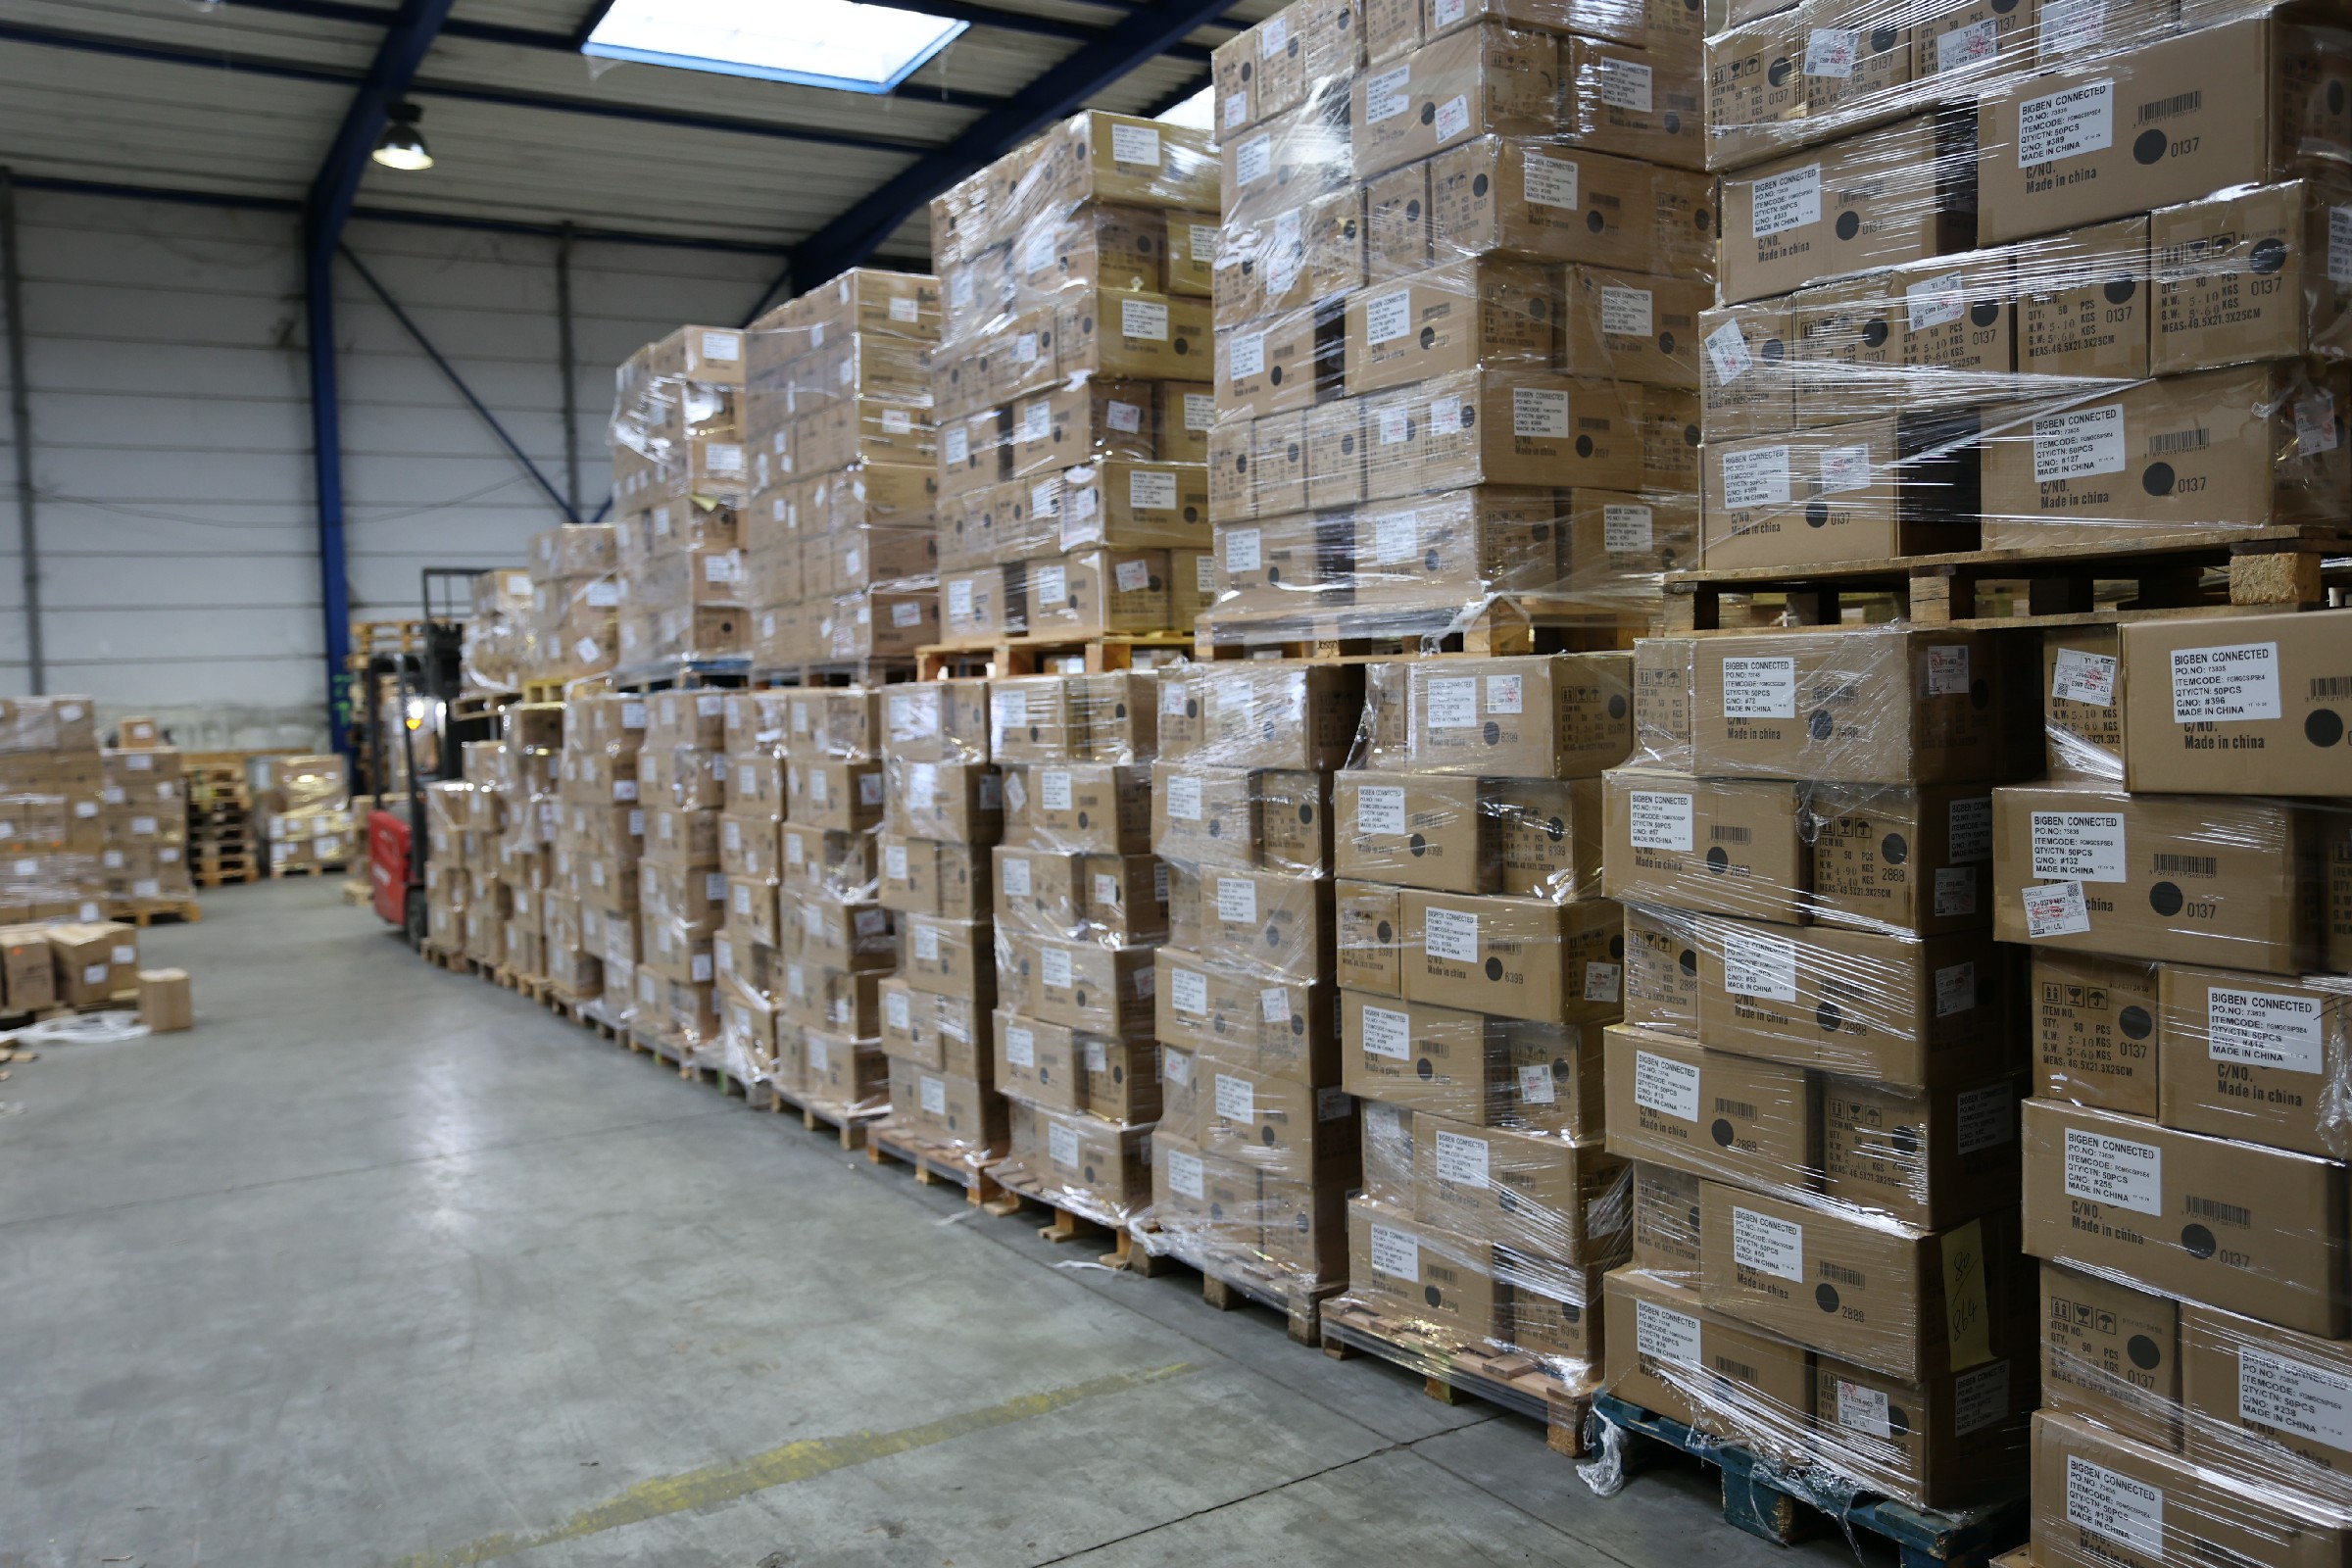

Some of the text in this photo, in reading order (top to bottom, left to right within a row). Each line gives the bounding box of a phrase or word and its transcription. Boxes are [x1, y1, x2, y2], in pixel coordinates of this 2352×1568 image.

[1769, 89, 1788, 105] 0137
[2023, 85, 2105, 115] BIGBEN CONNECTED
[2023, 112, 2049, 124] PO.NO:
[2022, 119, 2064, 134] ITEMCODE:
[2022, 123, 2080, 144] QTY/CTN: 50PCS
[2022, 136, 2064, 153] C/NO: #389
[2022, 151, 2043, 162] MADE
[2056, 142, 2080, 153] CHINA
[2171, 137, 2199, 157] 0137
[2027, 162, 2055, 179] C/NO.
[1755, 169, 1815, 193] BIGBEN CONNECTED
[2027, 168, 2096, 194] Made in china
[2196, 276, 2205, 287] 50
[2251, 276, 2281, 296] 0137
[2106, 307, 2132, 323] 0137
[1973, 329, 1995, 345] 0137
[2036, 410, 2116, 430] BIGBEN CONNECTED
[2036, 437, 2078, 449] ITEMCODE:
[2036, 445, 2093, 459] QTY/CTN: 50PCS
[2037, 459, 2058, 467] C/NO:
[2037, 466, 2058, 476] MADE
[2072, 462, 2094, 471] CHINA
[2179, 476, 2206, 493] 0137
[2041, 491, 2108, 509] Made in china
[2175, 649, 2269, 665] BIGBEN CONNECTED
[2176, 666, 2205, 675] PO.NO:
[2176, 676, 2224, 686] ITEMCODE:
[2176, 686, 2241, 697] QTY/CTN: 50PCS
[2177, 699, 2201, 708] C/NO:
[2217, 706, 2243, 714] CHINA
[2185, 735, 2265, 749] Made in china
[2034, 816, 2117, 827] BIGBEN CONNECTED
[2086, 898, 2113, 911] china
[2187, 903, 2216, 919] 0137
[1505, 972, 1523, 985] 6399
[2212, 993, 2312, 1013] BIGBEN CONNECTED
[2213, 1005, 2244, 1015] PO.NO:
[2043, 1005, 2075, 1018] ITEM NO:
[2043, 1018, 2111, 1035] QTY: 50 PCS
[2212, 1016, 2263, 1029] ITEMCODE:
[2096, 1038, 2111, 1048] KGS
[2252, 1031, 2281, 1042] 50PCS
[2096, 1050, 2111, 1060] KGS
[2121, 1043, 2147, 1058] 0137
[2213, 1046, 2283, 1061] MADE IN CHINA
[2218, 1063, 2252, 1082] C/NO.
[2218, 1080, 2301, 1106] Made in china
[2068, 1133, 2154, 1159] BIGBEN CONNECTED
[2069, 1145, 2096, 1156] PO.NO:
[2069, 1154, 2112, 1170] ITEMCODE:
[2068, 1163, 2128, 1184] QTY/CTN: 50PCS
[2069, 1173, 2089, 1185] C/NO:
[2069, 1182, 2090, 1193] MADE
[2103, 1190, 2129, 1201] CHINA
[2072, 1200, 2102, 1220] C/NO.
[2072, 1216, 2144, 1245] Made in china
[2220, 1250, 2250, 1267] 0137
[2243, 1396, 2268, 1408] C/NO:
[2070, 1501, 2113, 1523] C/NO: #139
